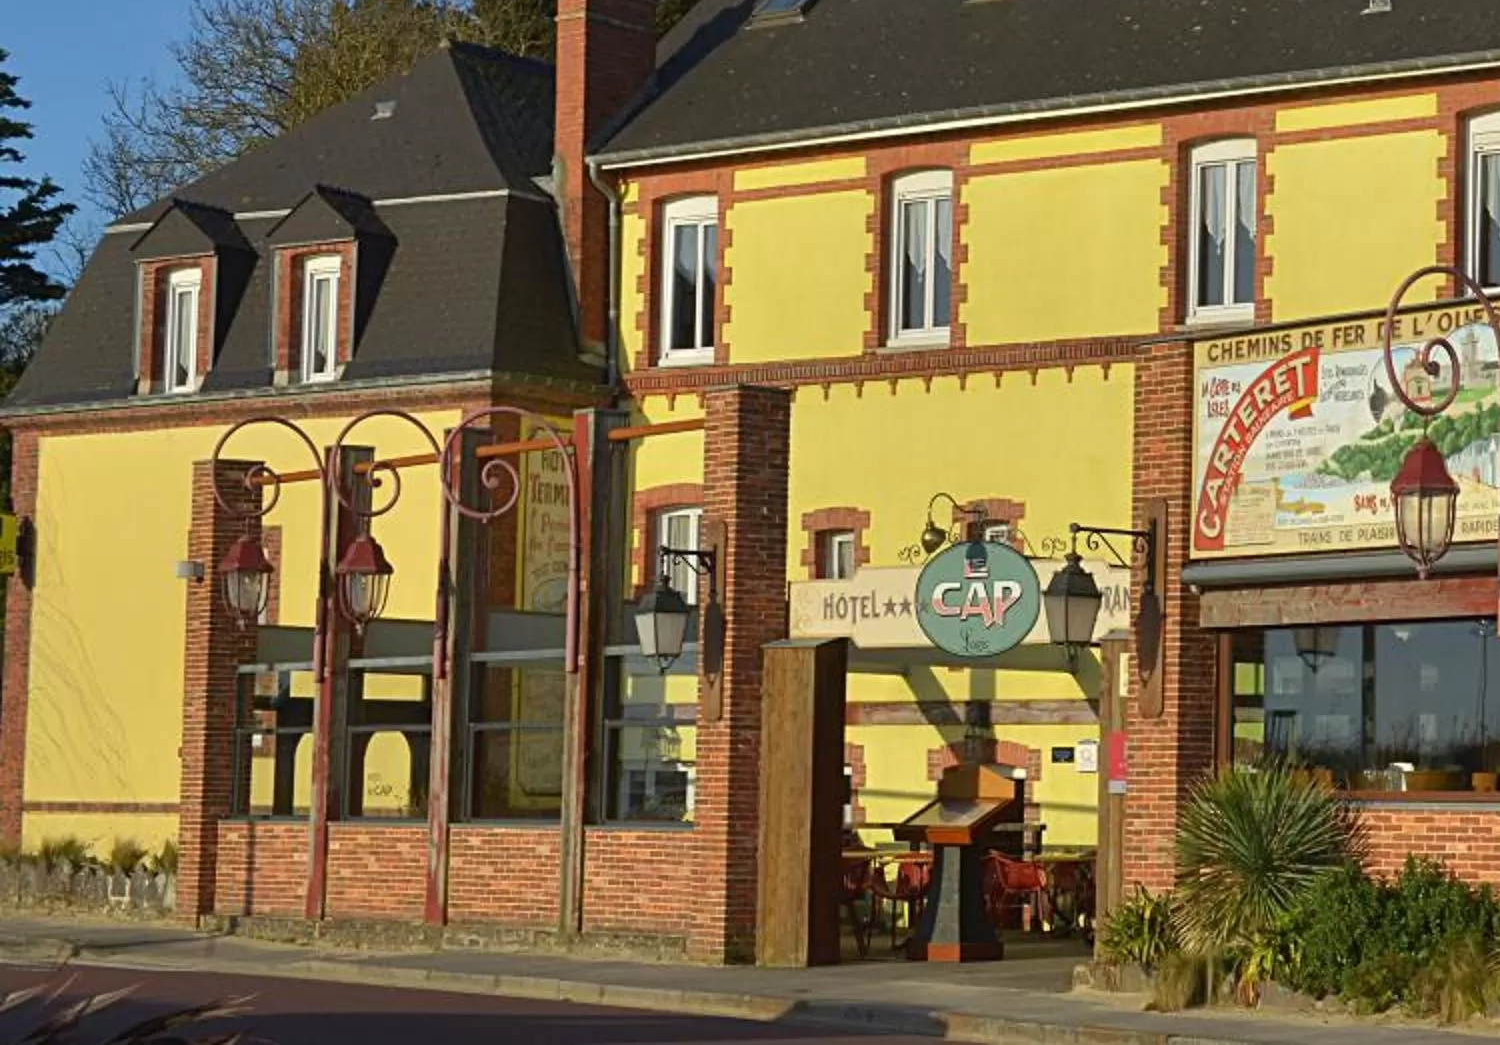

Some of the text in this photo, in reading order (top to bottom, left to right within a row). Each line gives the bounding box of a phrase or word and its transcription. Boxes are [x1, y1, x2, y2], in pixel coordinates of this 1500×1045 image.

[1207, 333, 1293, 363] CHEMINS
[1301, 330, 1325, 349] DE
[1332, 324, 1366, 348] FER
[1199, 355, 1313, 539] CARTERET
[1339, 529, 1353, 543] DE
[1461, 518, 1500, 534] RAPIDE
[962, 557, 990, 579] LE
[931, 580, 1023, 629] CAP
